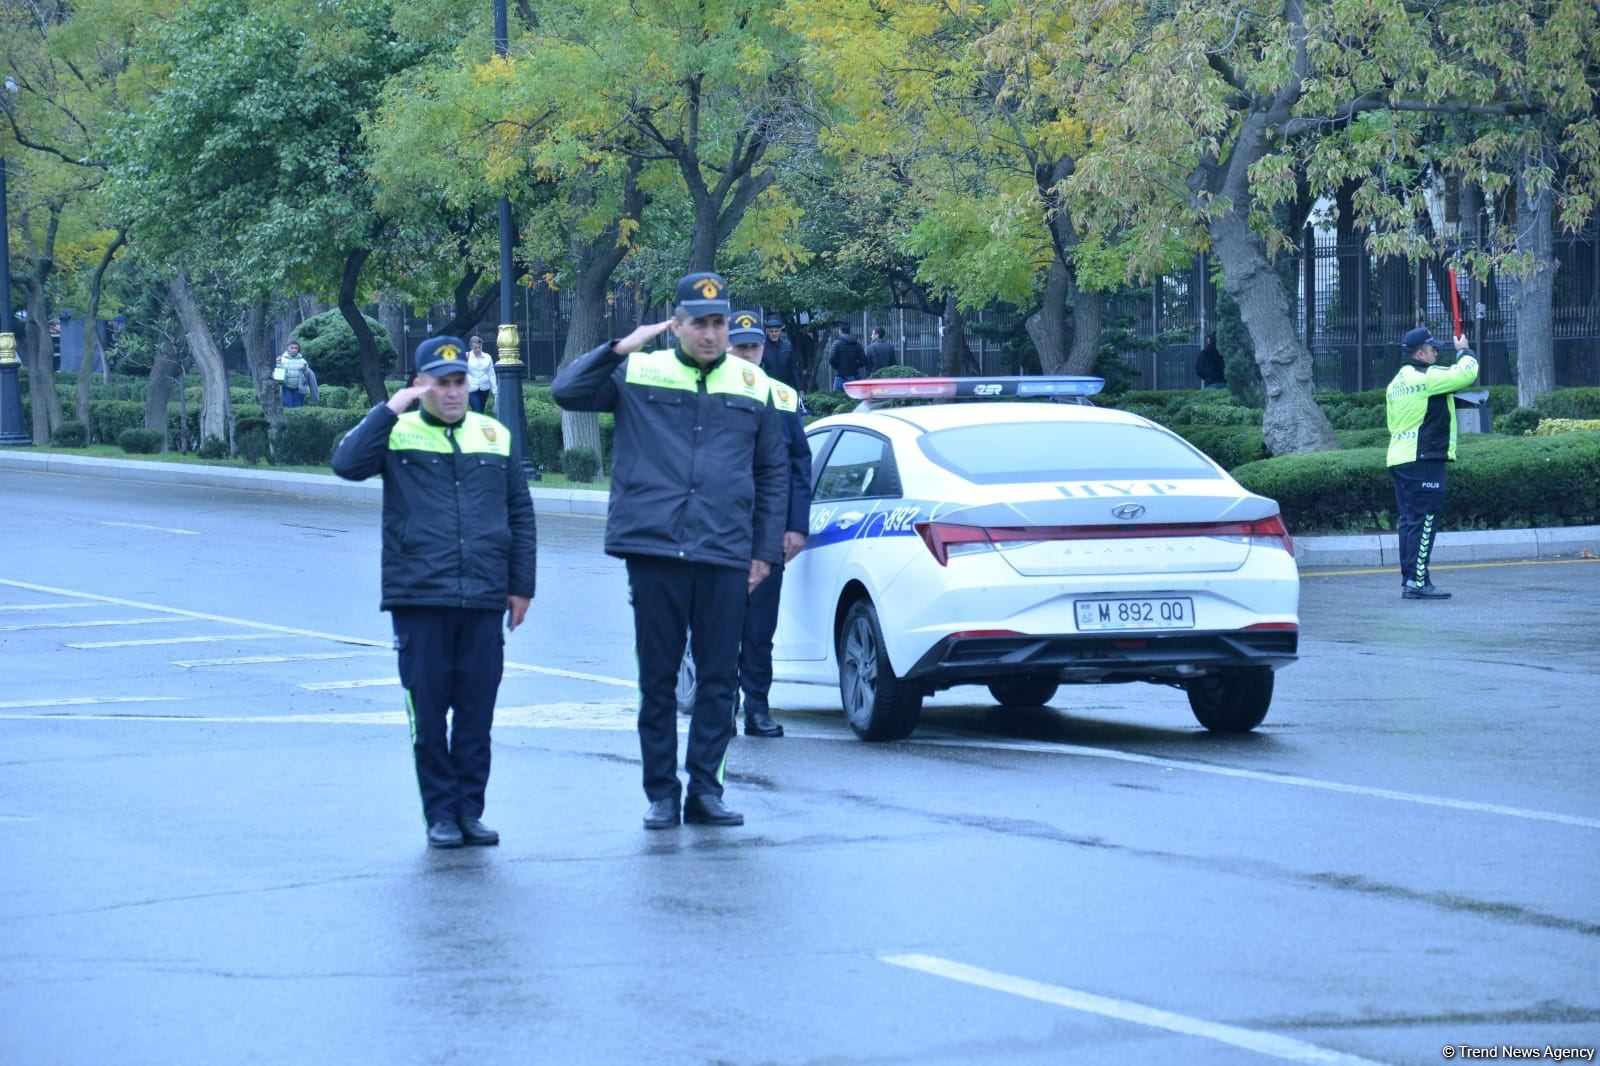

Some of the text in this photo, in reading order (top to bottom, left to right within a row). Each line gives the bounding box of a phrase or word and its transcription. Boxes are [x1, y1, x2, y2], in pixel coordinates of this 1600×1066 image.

[885, 506, 921, 531] 892
[1098, 601, 1184, 622] M 892 QQ
